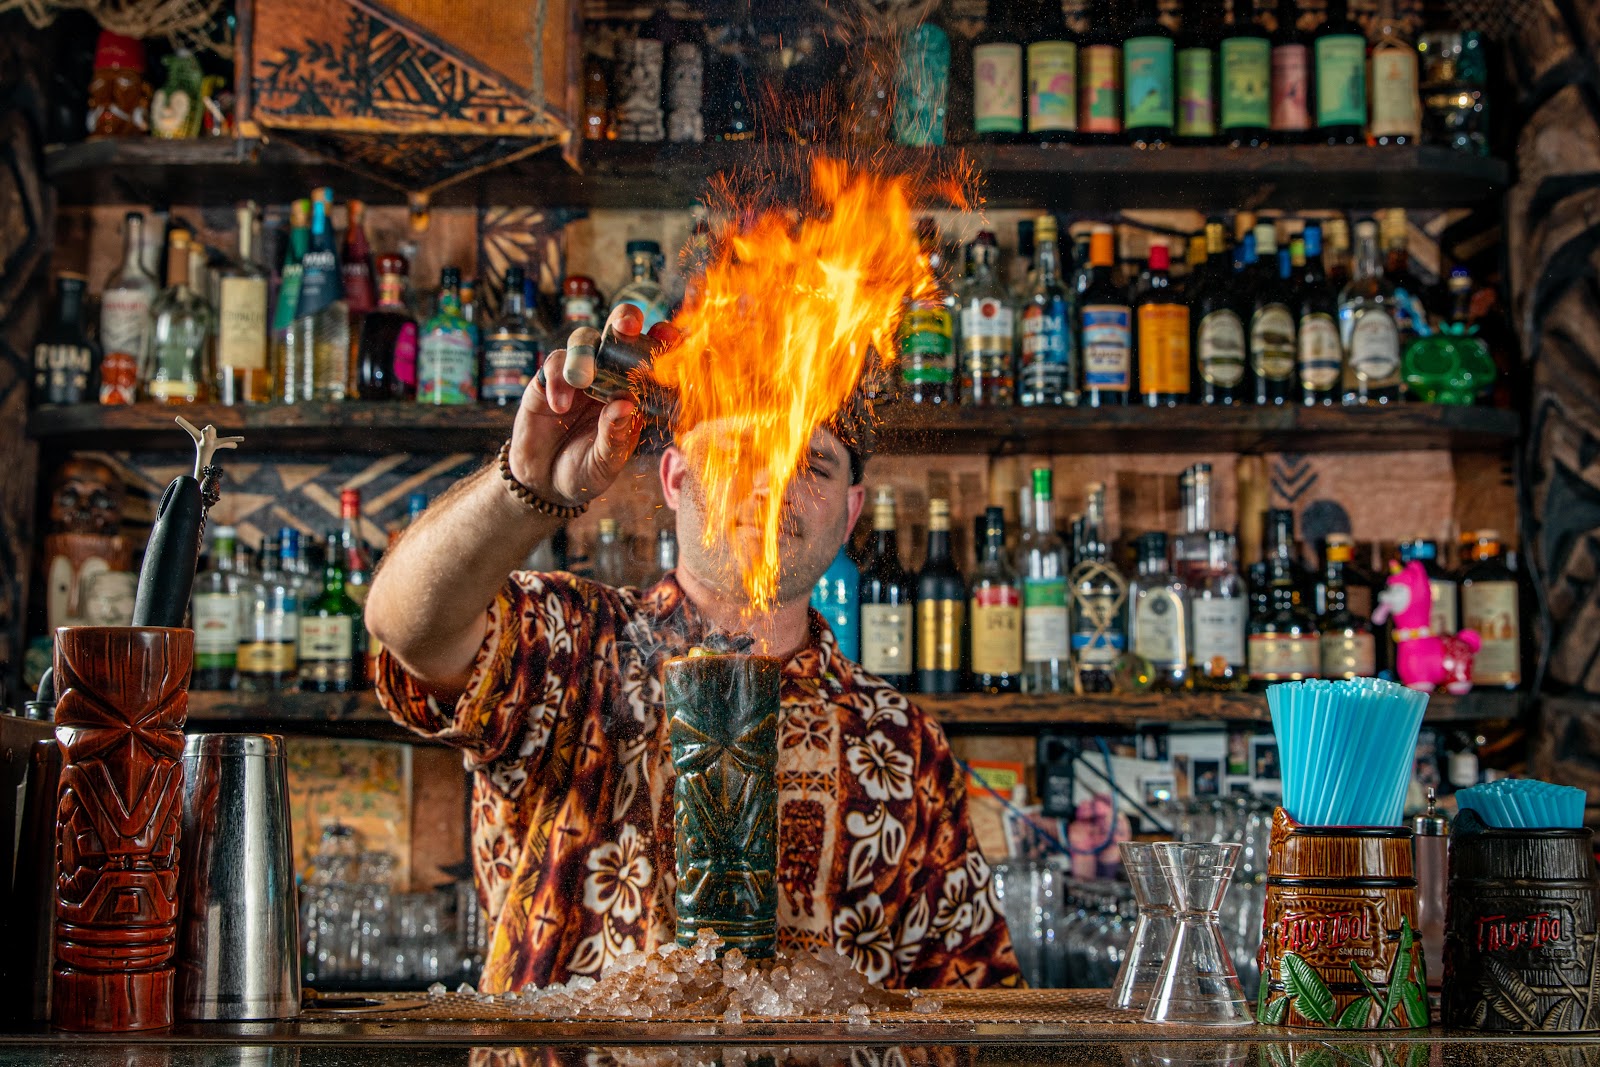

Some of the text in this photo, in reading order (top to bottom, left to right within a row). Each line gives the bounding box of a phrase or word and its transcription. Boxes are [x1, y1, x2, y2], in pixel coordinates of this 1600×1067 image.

[35, 344, 92, 372] RUM
[1281, 907, 1372, 951] FALSE IDOL
[1476, 907, 1571, 952] FALSE IDOL
[1339, 948, 1374, 957] SAN DIEGO
